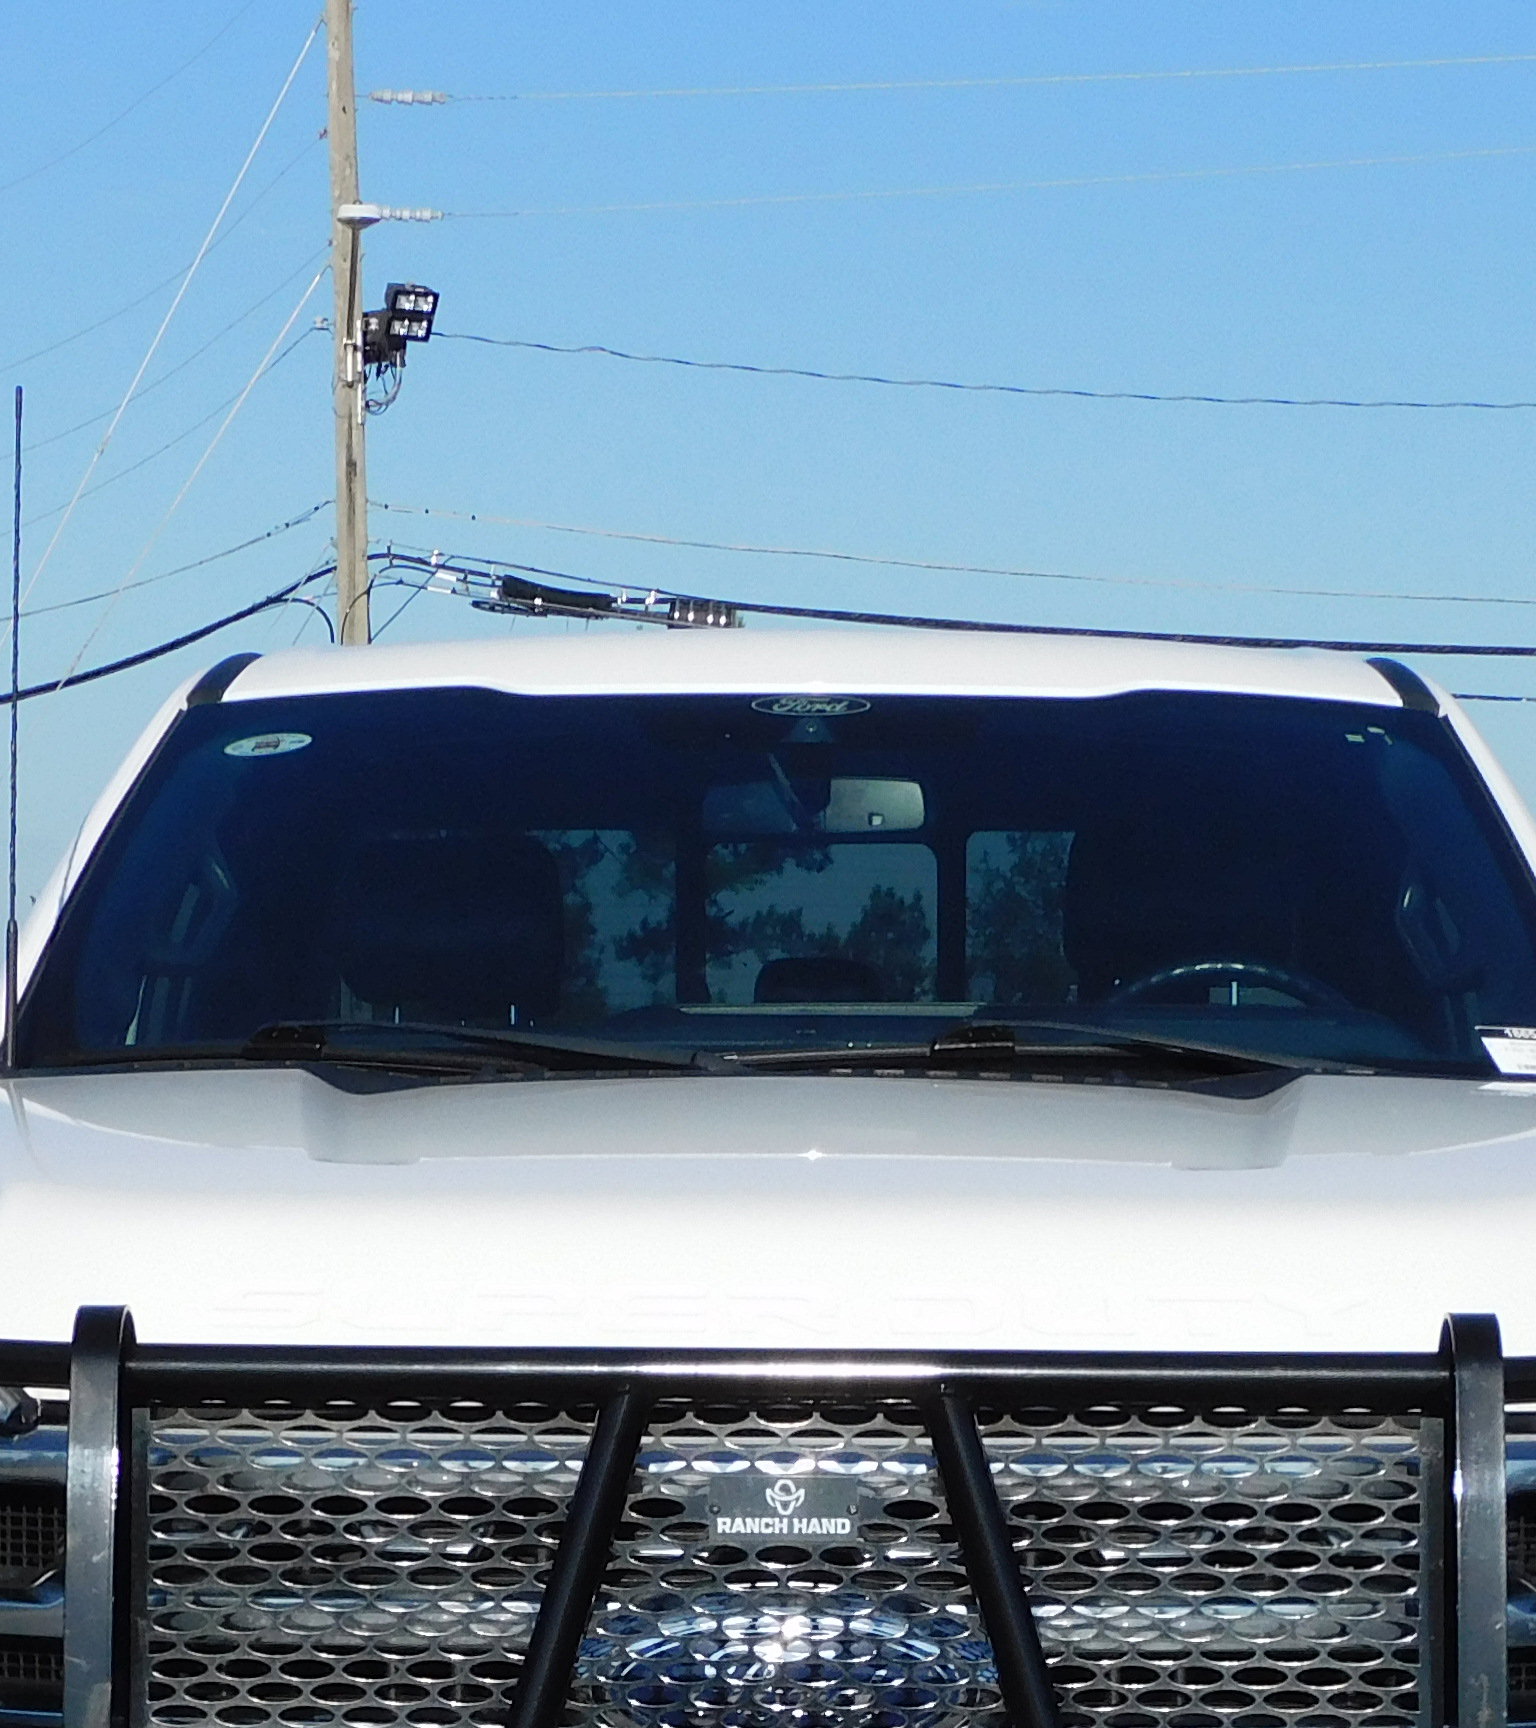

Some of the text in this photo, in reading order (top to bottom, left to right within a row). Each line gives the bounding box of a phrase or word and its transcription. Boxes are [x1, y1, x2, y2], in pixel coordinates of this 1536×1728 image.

[772, 697, 849, 713] Ford
[716, 1517, 851, 1535] RANCH HAND
